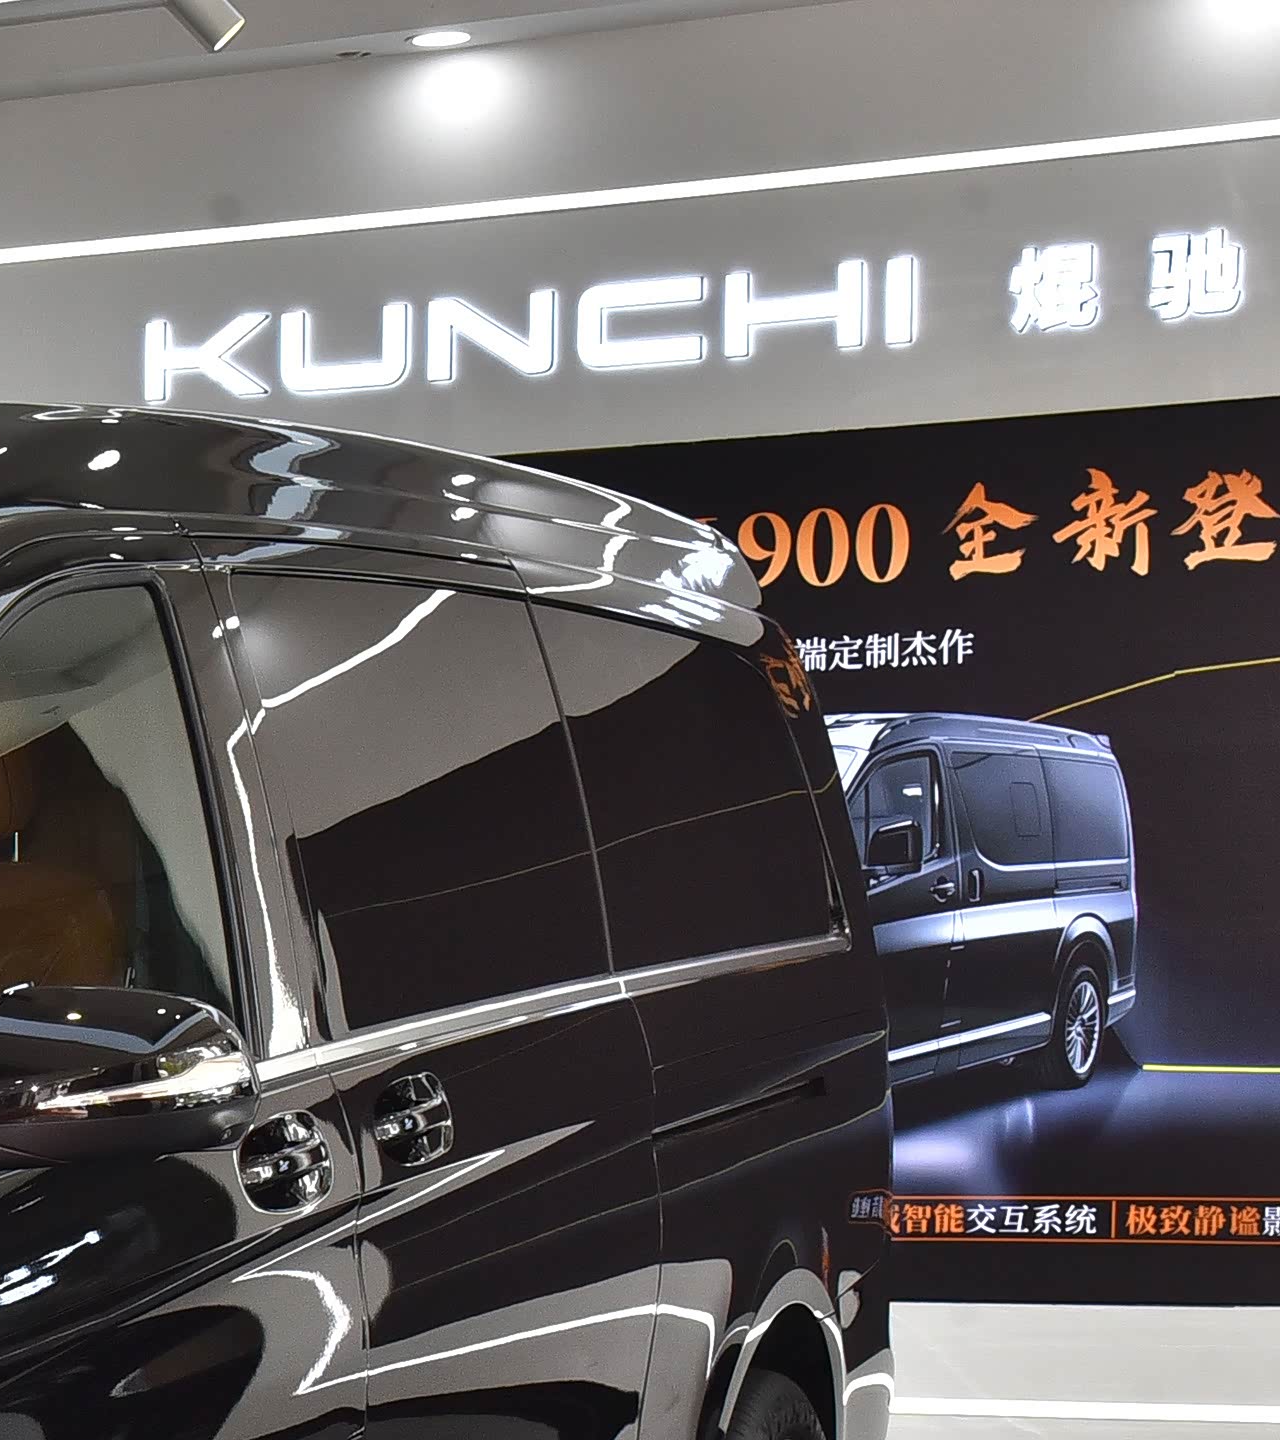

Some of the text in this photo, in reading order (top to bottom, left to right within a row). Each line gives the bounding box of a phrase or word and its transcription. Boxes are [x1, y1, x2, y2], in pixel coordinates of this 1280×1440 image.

[142, 254, 917, 402] KUNCHI
[697, 467, 1280, 587] 900 全新登
[795, 628, 975, 674] 端定制杰作
